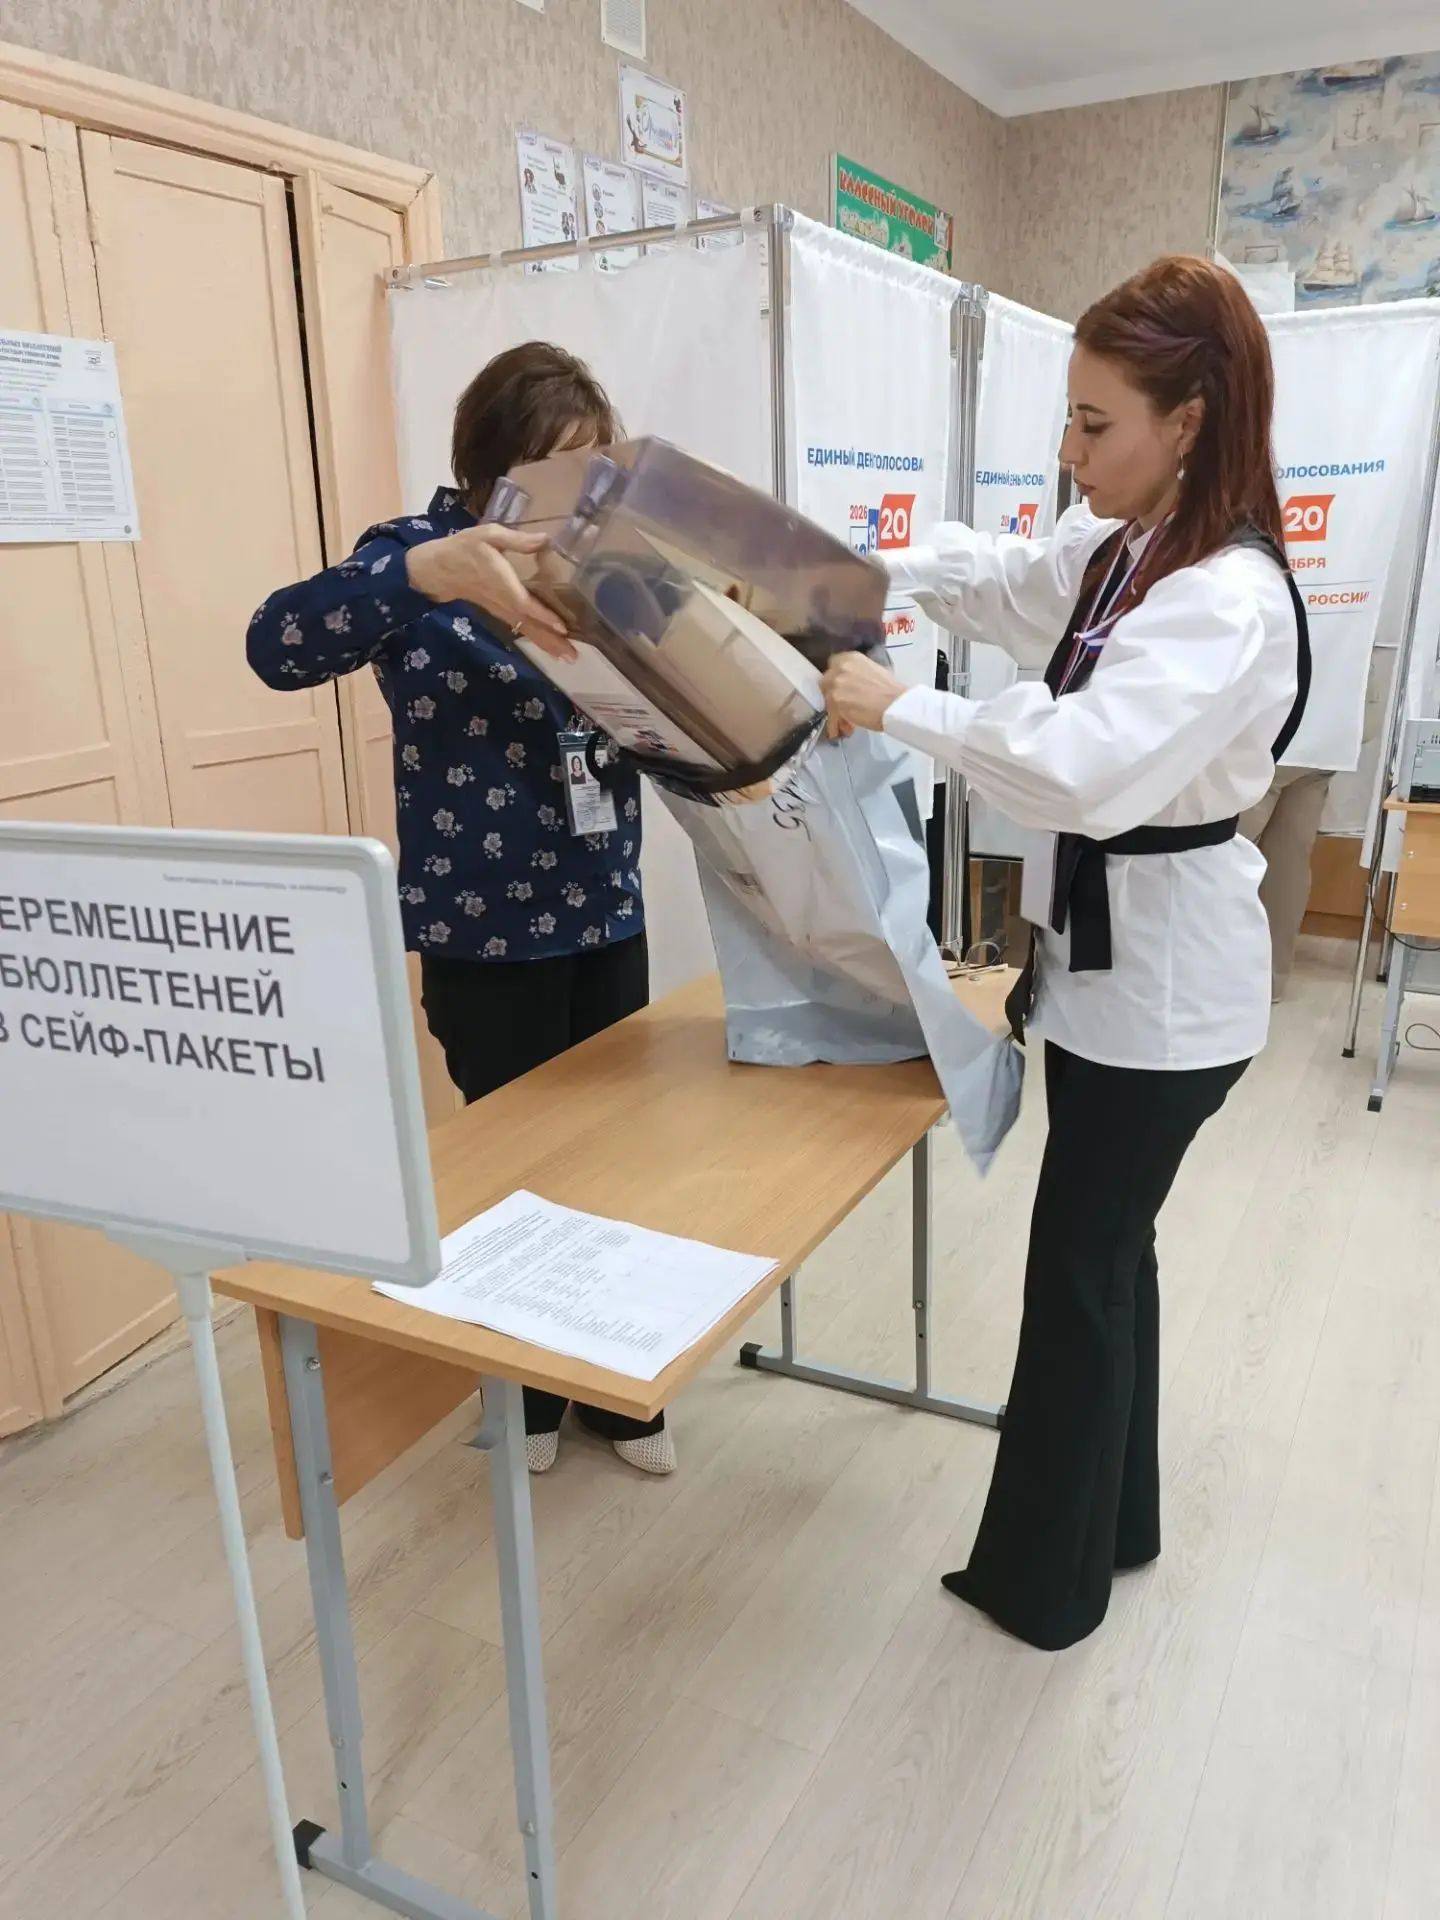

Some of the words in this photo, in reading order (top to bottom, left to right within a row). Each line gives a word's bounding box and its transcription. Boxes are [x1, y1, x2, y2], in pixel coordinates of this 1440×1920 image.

[840, 168, 897, 218] КЛАССНЫЙ
[896, 199, 934, 237] УГОЛОК
[850, 505, 867, 520] 2026
[880, 507, 908, 540] 20
[1285, 505, 1325, 533] 20
[0, 952, 285, 1018] БЮЛЛЕТЕНЕЙ
[21, 1009, 326, 1083] СЕЙФ-ПАКЕТЫ
